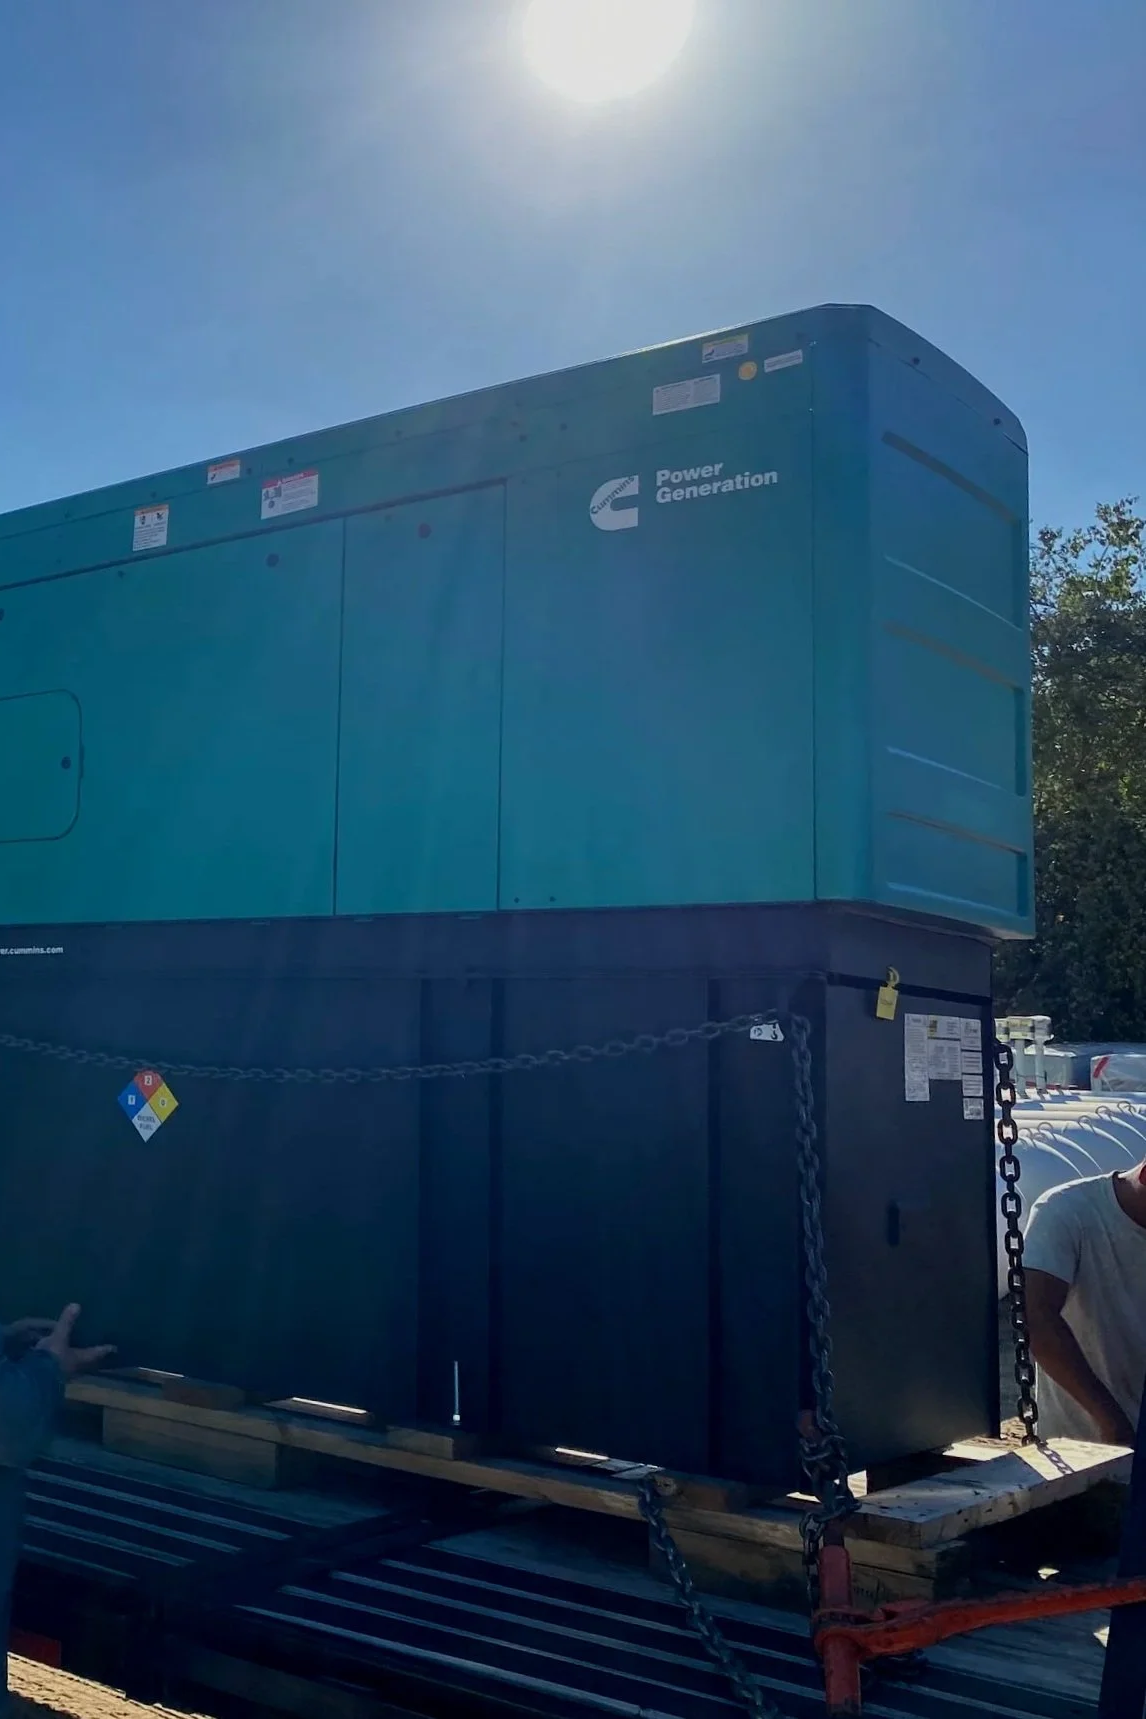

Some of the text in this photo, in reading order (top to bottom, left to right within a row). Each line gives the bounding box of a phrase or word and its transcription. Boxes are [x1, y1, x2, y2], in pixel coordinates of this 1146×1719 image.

[656, 462, 723, 487] Power
[656, 471, 778, 503] Generation
[590, 476, 636, 515] Cummins
